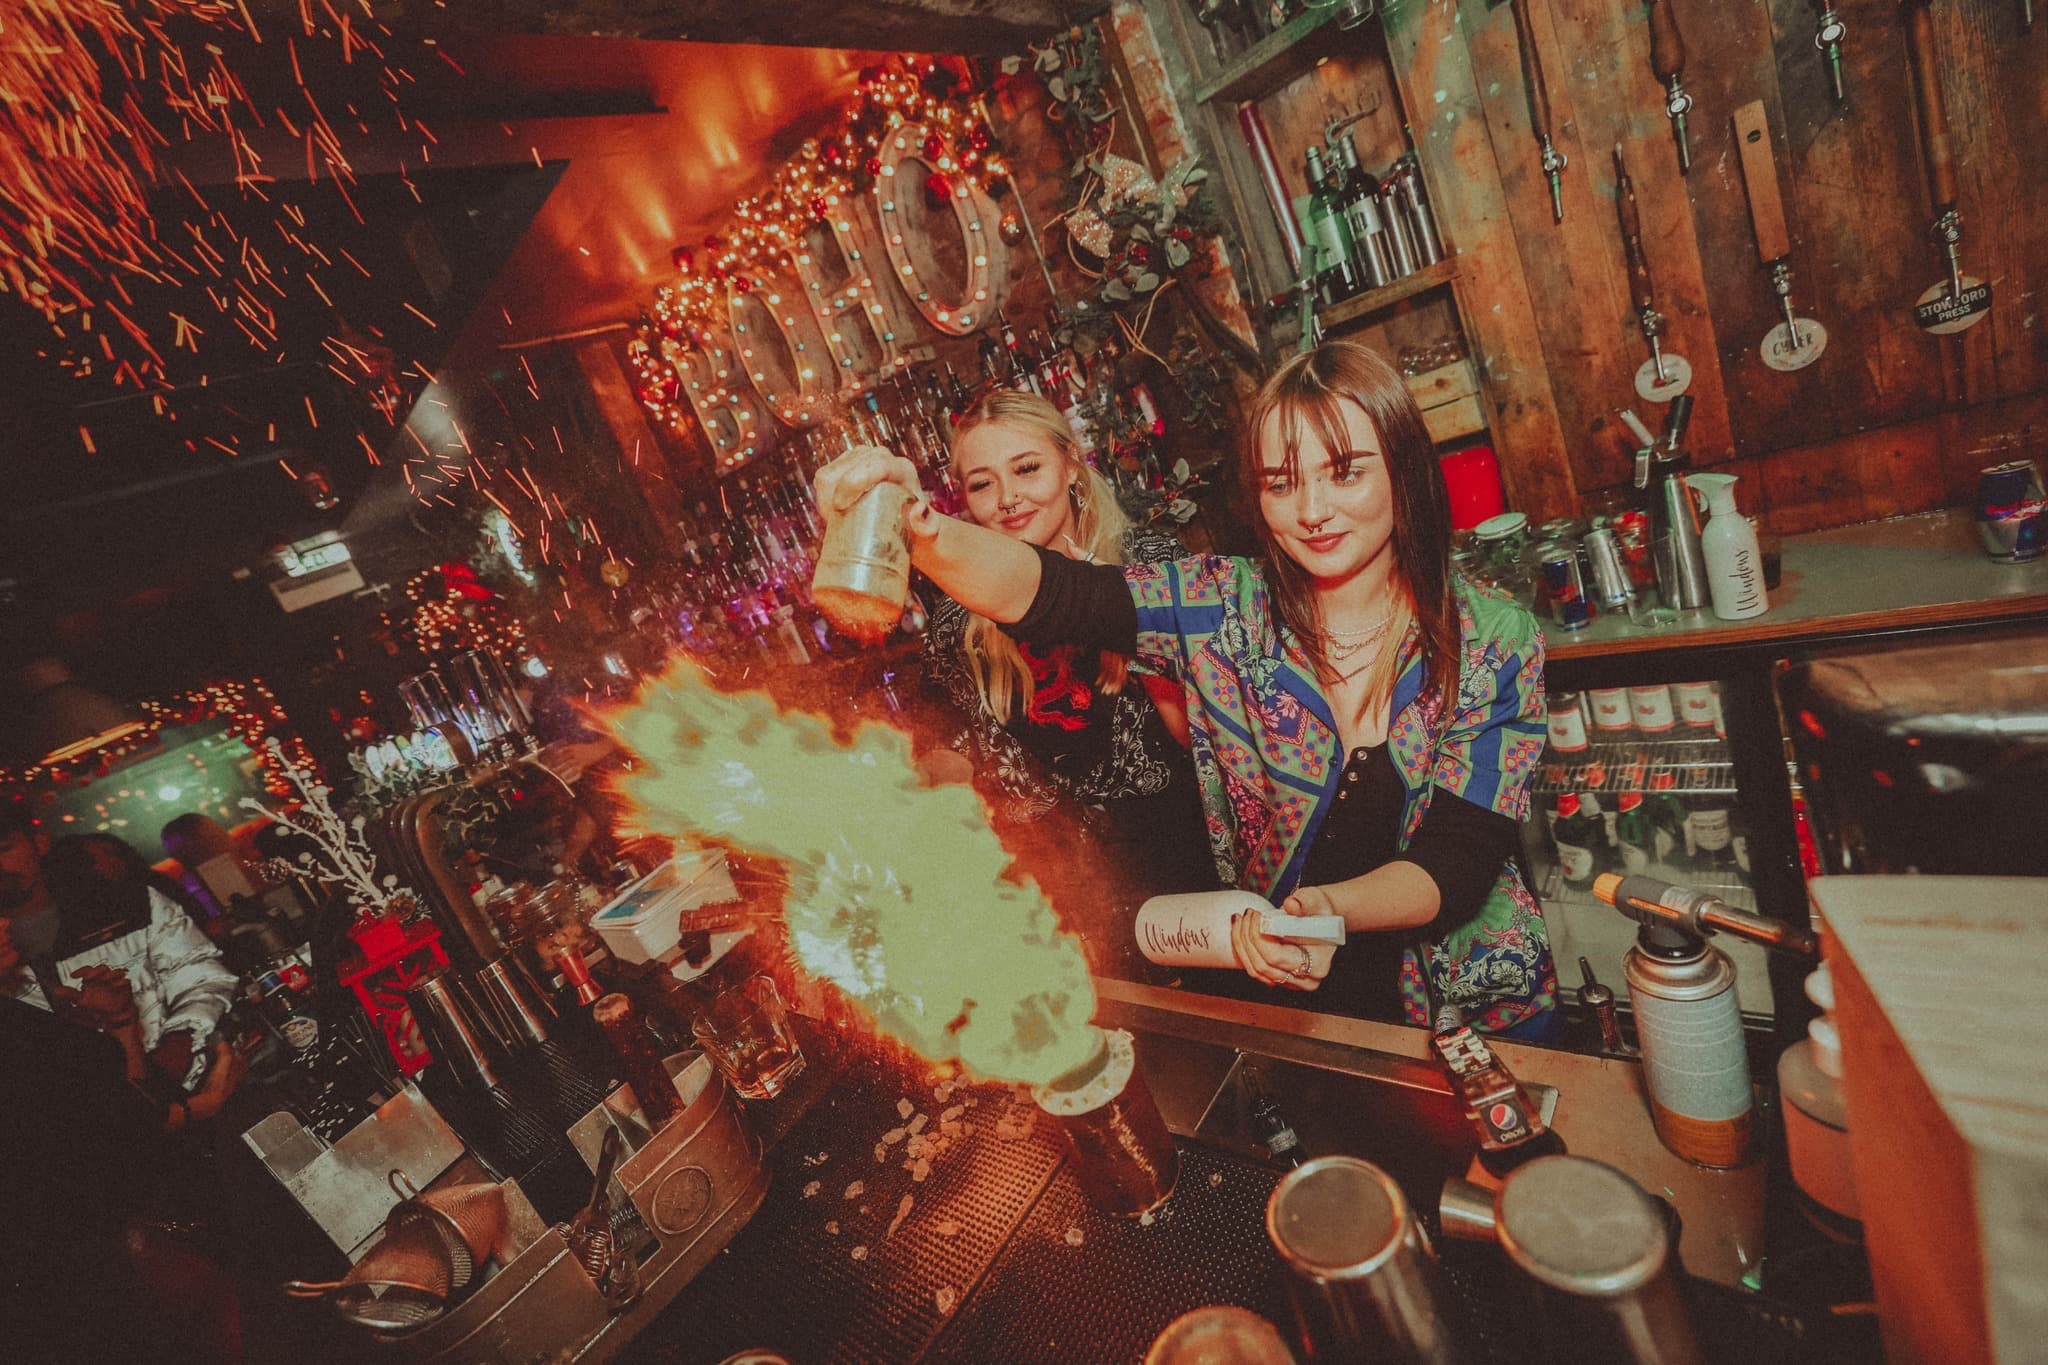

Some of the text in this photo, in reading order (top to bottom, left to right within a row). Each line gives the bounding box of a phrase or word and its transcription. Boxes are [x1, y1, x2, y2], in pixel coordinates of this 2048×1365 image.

[670, 120, 1000, 476] BOHO
[1919, 288, 1987, 318] STOWORD
[1938, 304, 1971, 321] PRESS
[1728, 550, 1759, 612] Windows
[1144, 916, 1210, 954] Windows
